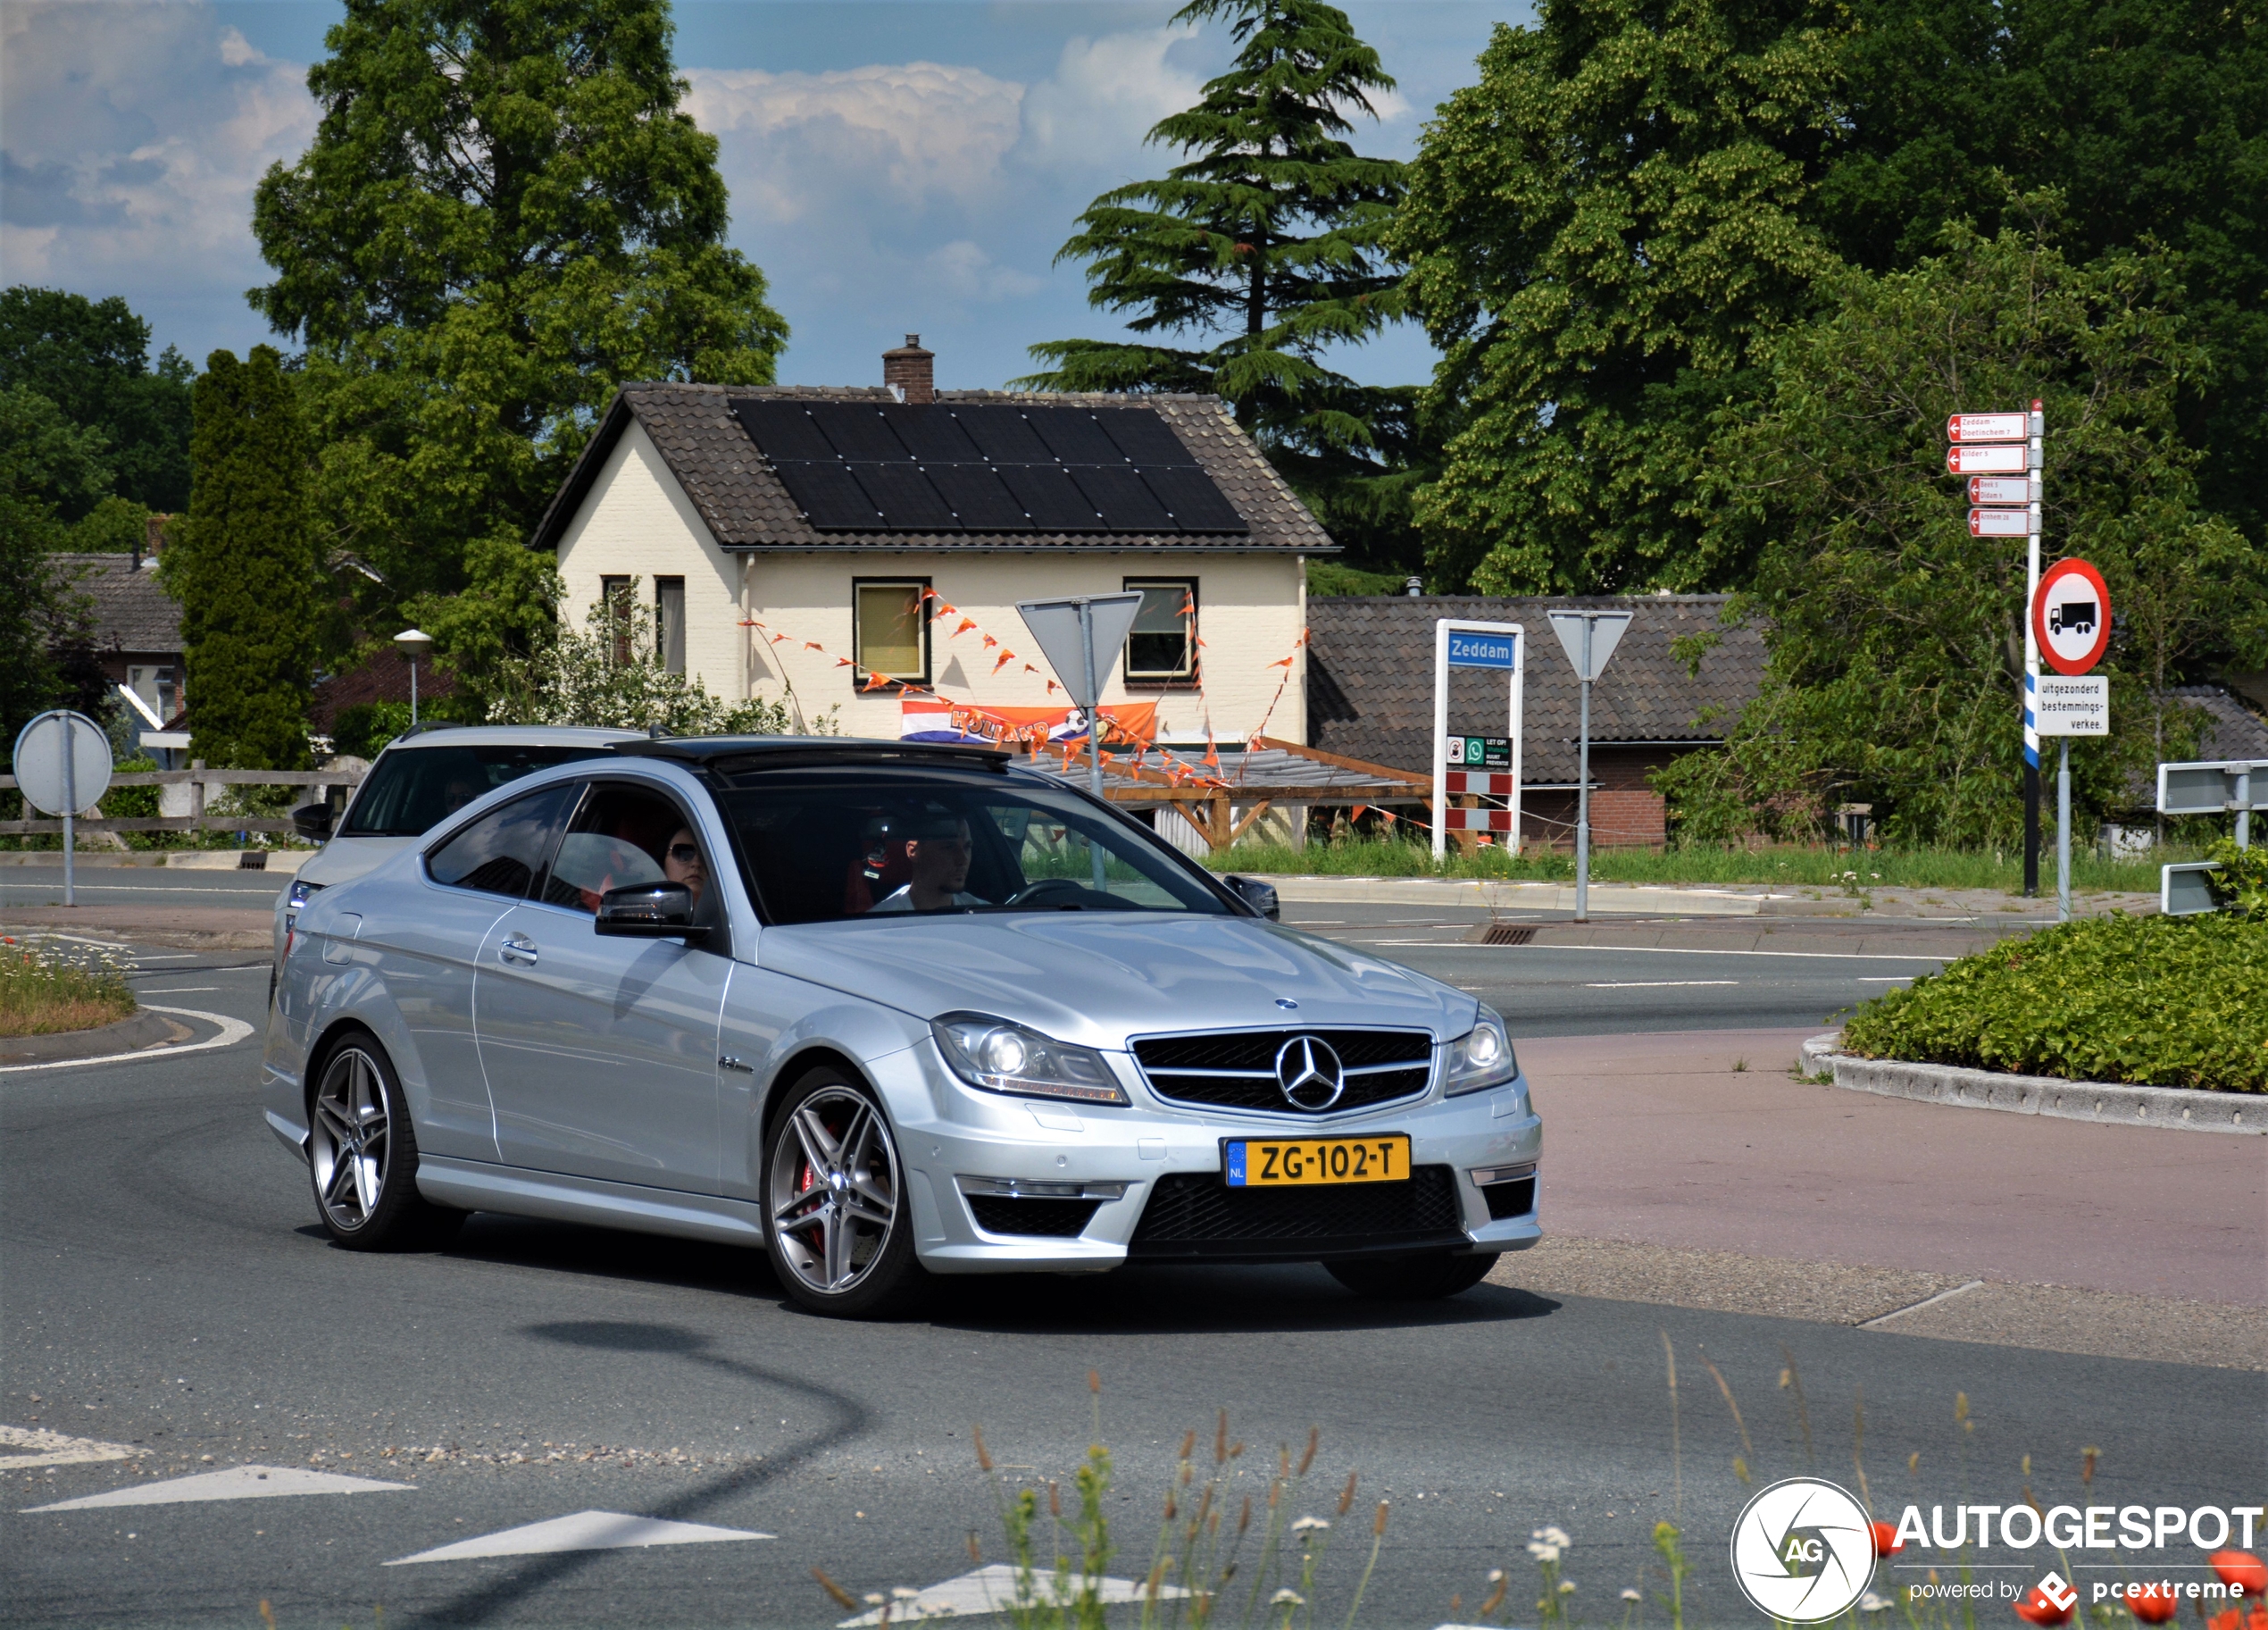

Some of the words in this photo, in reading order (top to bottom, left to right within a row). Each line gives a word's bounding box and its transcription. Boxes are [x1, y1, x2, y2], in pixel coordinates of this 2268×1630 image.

[1962, 418, 1990, 426] Zeddam
[1962, 429, 2005, 437] Doetinchem
[1452, 639, 1509, 659] Zeddam
[2042, 683, 2099, 697] uitgezonderd
[2042, 701, 2104, 715] bestemmings-
[951, 710, 1050, 742] HOLLAND
[1261, 1142, 1394, 1179] ZG-102-T
[1230, 1167, 1244, 1178] NL
